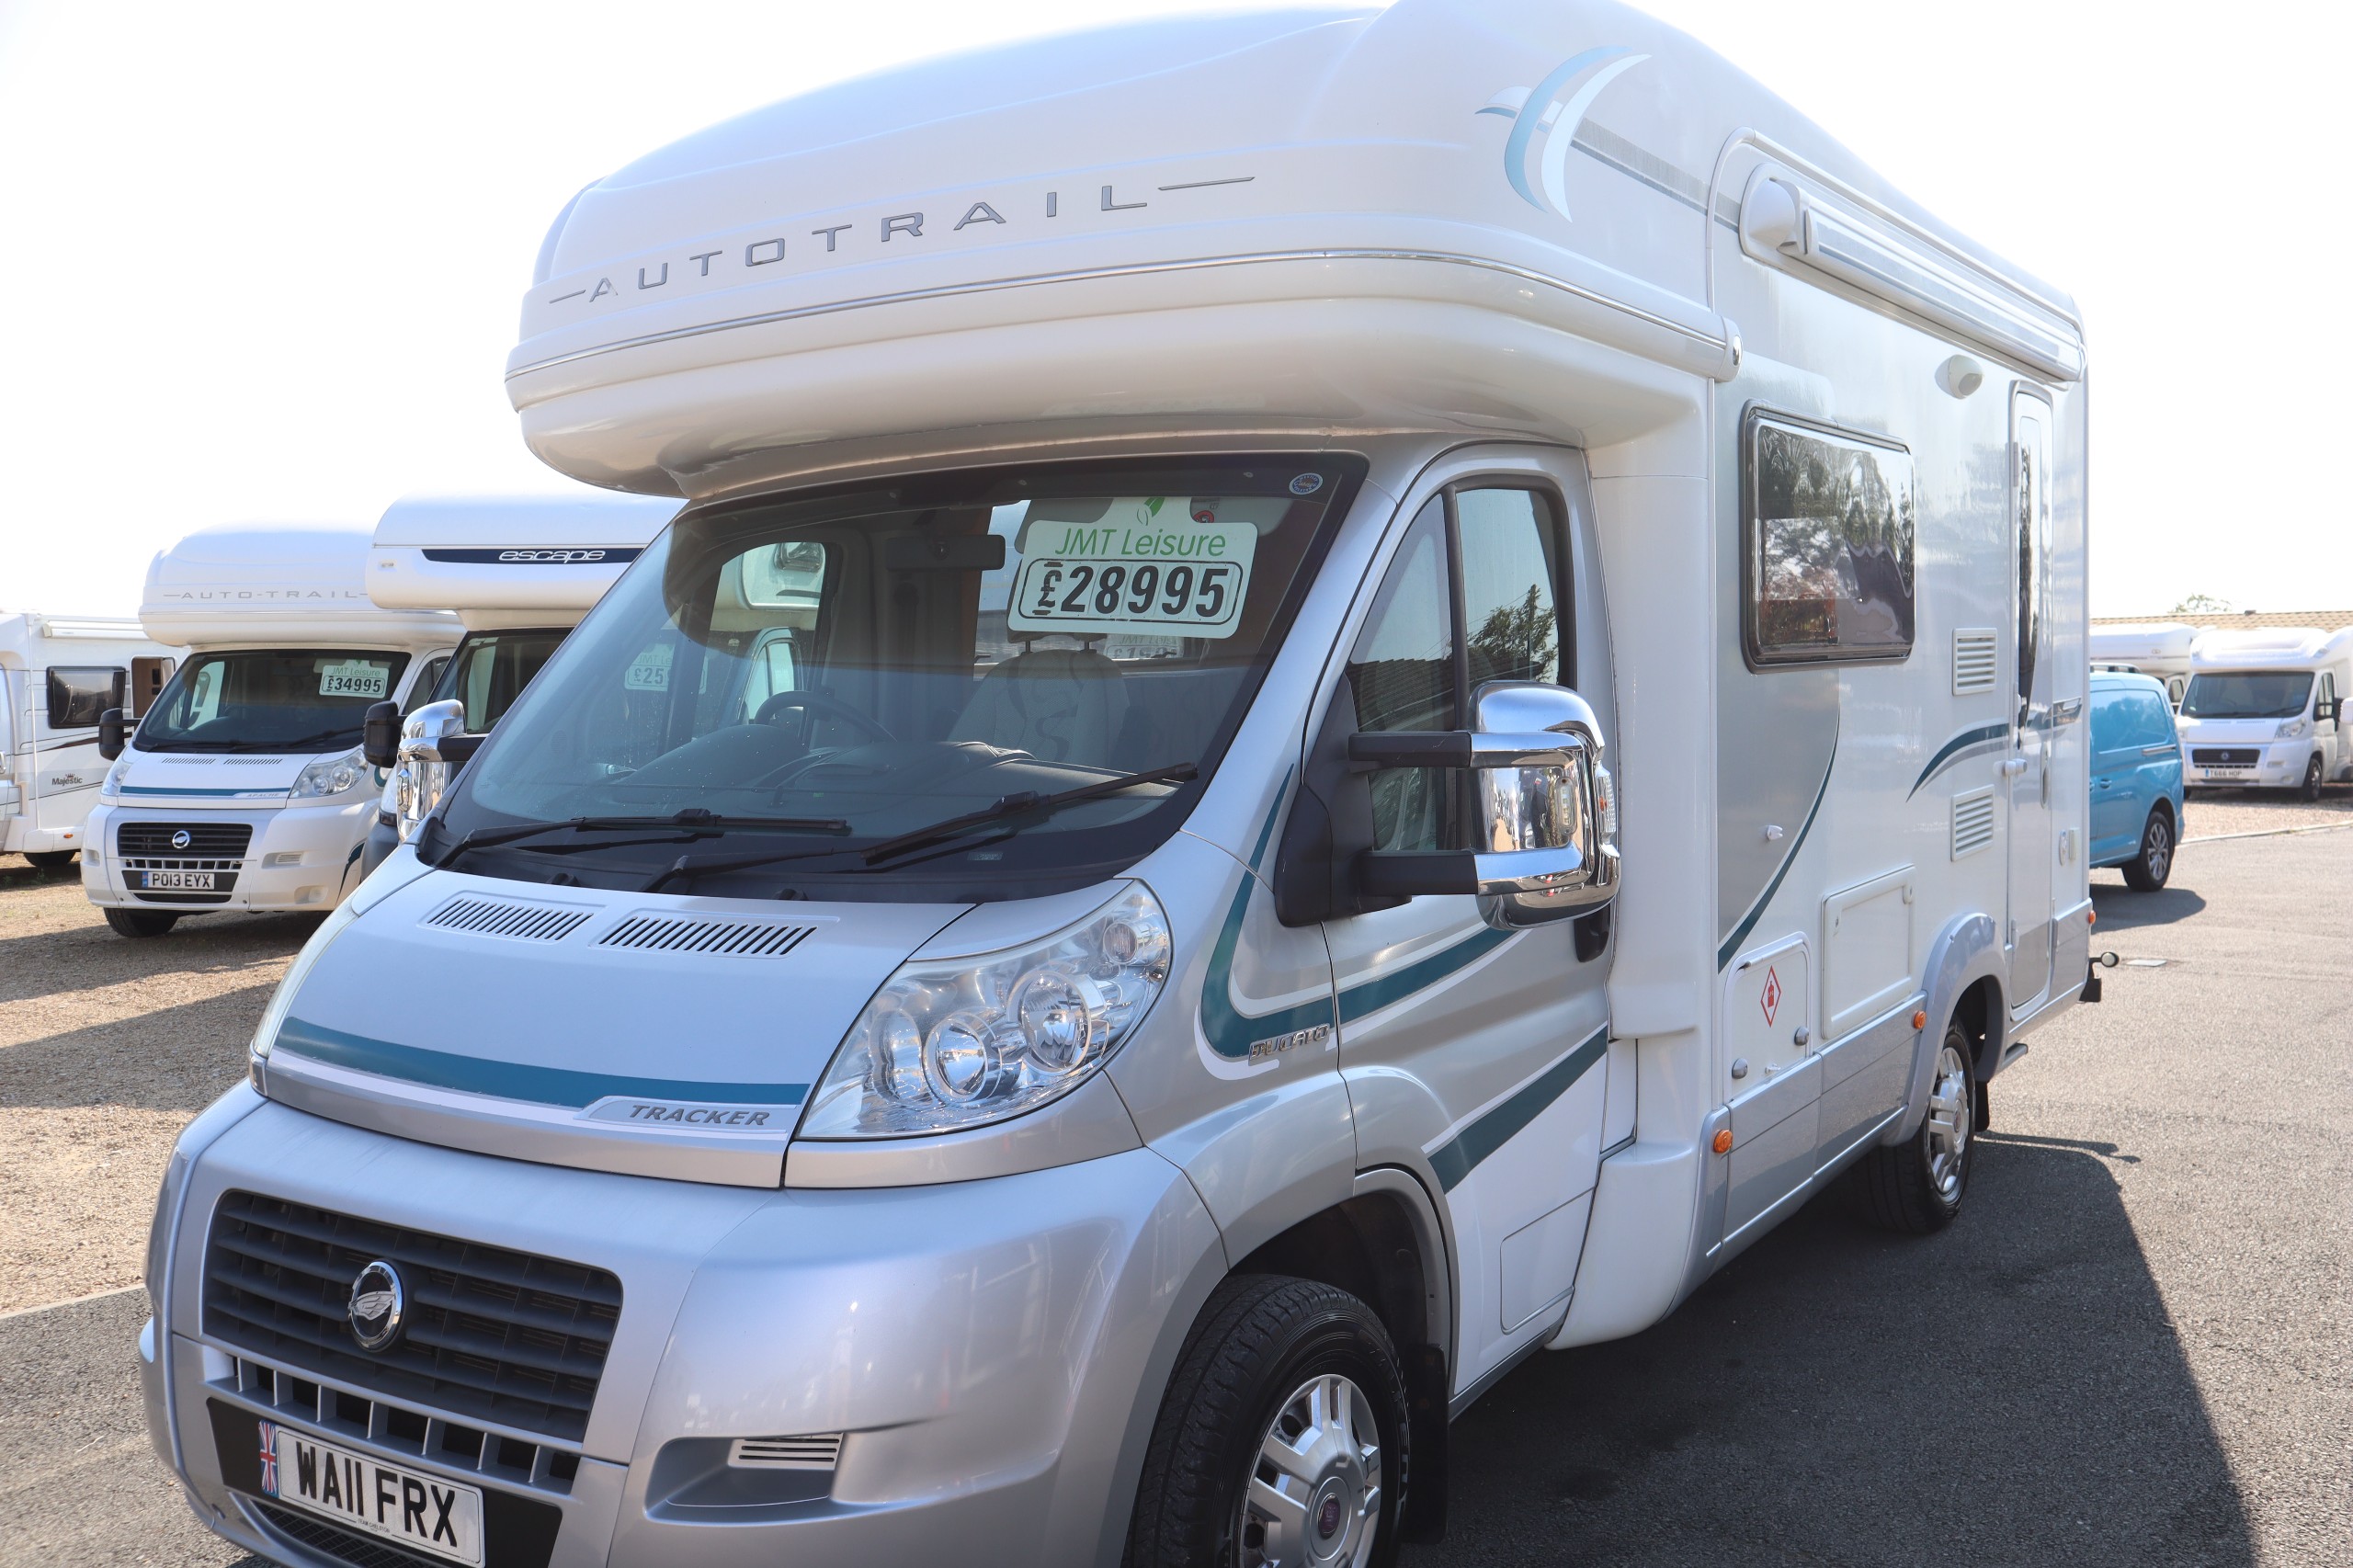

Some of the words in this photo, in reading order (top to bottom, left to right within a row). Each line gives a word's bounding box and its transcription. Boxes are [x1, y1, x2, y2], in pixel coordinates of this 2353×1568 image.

[588, 185, 1148, 302] AUTOTRAIL
[1054, 528, 1118, 557] JMT
[1120, 528, 1227, 558] Leisure
[498, 550, 607, 564] escape
[180, 590, 358, 599] AUTO-TRAIL
[1036, 562, 1230, 618] £28995
[331, 666, 348, 676] JMT
[350, 667, 381, 677] Leisure
[326, 677, 381, 693] £34995
[51, 776, 84, 787] Majestic
[152, 872, 181, 887] PO13
[185, 873, 210, 889] EYX
[1249, 1024, 1330, 1061] DUCATO
[629, 1104, 770, 1127] TRACKER
[295, 1440, 365, 1517] WA11
[374, 1467, 458, 1548] FRX
